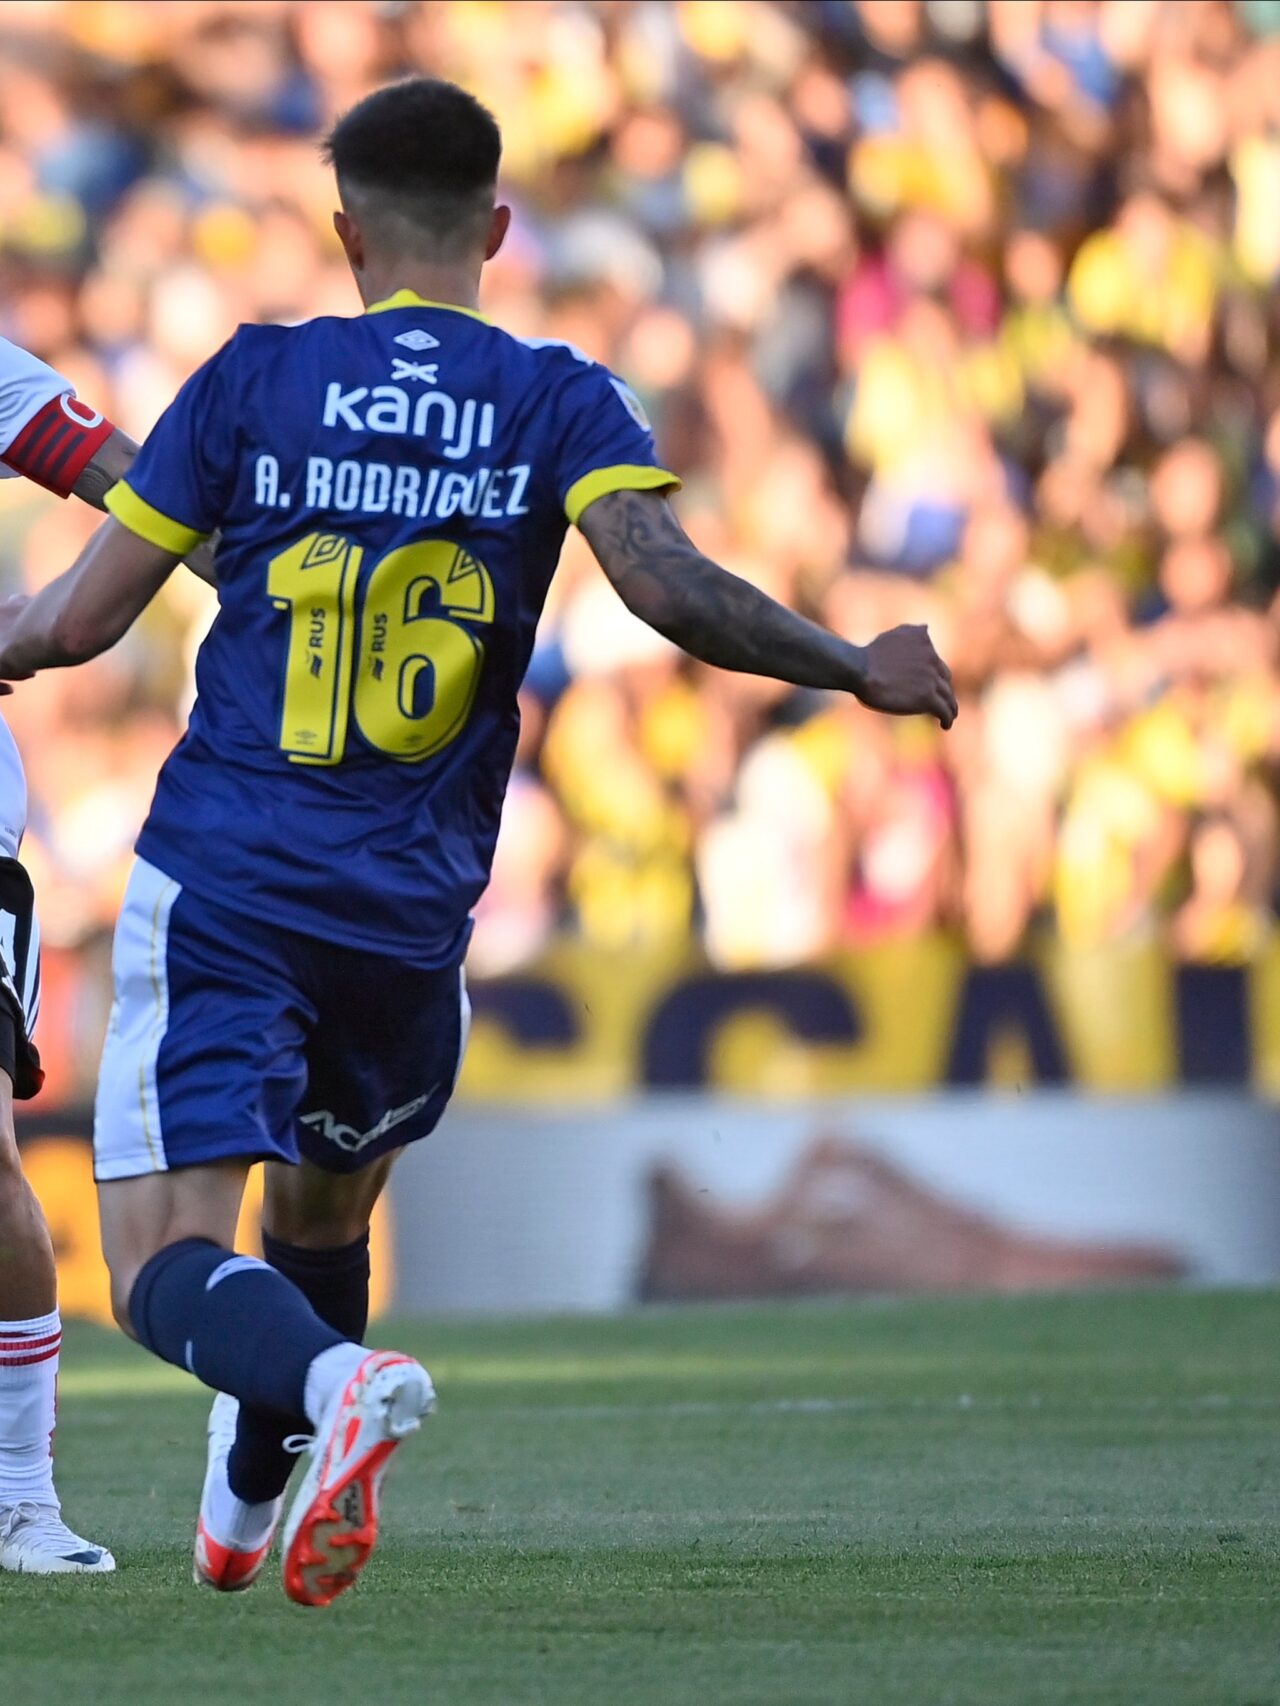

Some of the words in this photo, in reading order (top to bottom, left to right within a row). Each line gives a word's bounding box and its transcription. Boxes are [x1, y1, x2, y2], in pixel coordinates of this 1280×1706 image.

[254, 454, 291, 508] A.
[305, 456, 532, 518] RODRIGUEZ
[266, 531, 496, 767] 16
[309, 607, 326, 649] RUS
[371, 612, 388, 652] RUS
